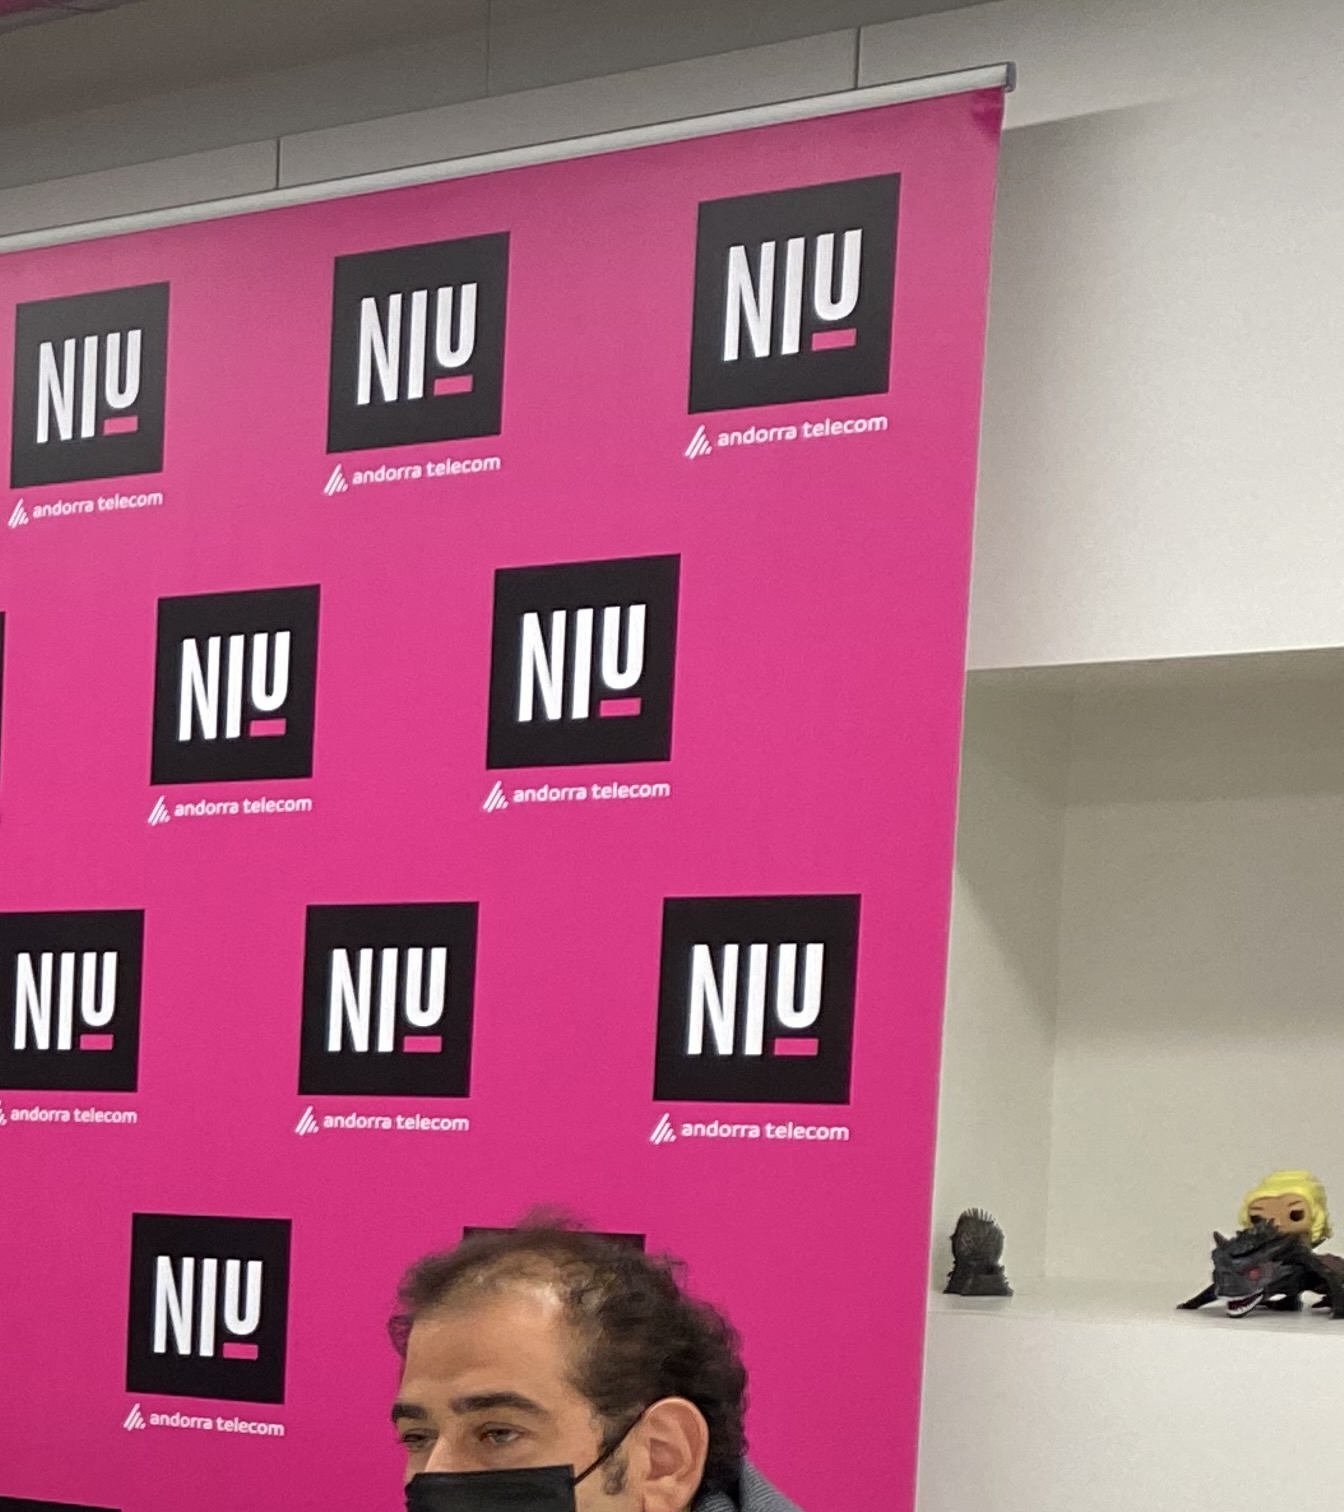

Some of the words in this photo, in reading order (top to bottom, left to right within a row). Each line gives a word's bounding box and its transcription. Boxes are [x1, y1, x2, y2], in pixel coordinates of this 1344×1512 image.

[724, 229, 861, 361] NIU
[357, 283, 476, 405] NIU
[37, 330, 141, 443] NIU
[717, 425, 798, 447] andorra
[801, 416, 888, 439] telecom
[352, 465, 422, 485] andorra
[425, 456, 501, 477] telecom
[32, 499, 95, 519] andorra
[97, 492, 163, 512] telecom
[179, 631, 290, 741] NIU
[518, 604, 645, 722] NIU
[173, 799, 240, 817] andorra
[242, 796, 313, 814] telecom
[512, 784, 588, 803] andorra
[590, 781, 671, 800] telecom
[15, 952, 117, 1050] NIU
[328, 948, 446, 1052] NIU
[687, 944, 823, 1055] NIU
[10, 1106, 71, 1123] andorra
[73, 1107, 138, 1124] telecom
[323, 1112, 393, 1130] andorra
[395, 1113, 470, 1131] telecom
[681, 1120, 761, 1139] andorra
[764, 1121, 850, 1141] telecom
[154, 1256, 262, 1356] NIU
[149, 1411, 214, 1430] andorra
[215, 1416, 285, 1436] telecom
